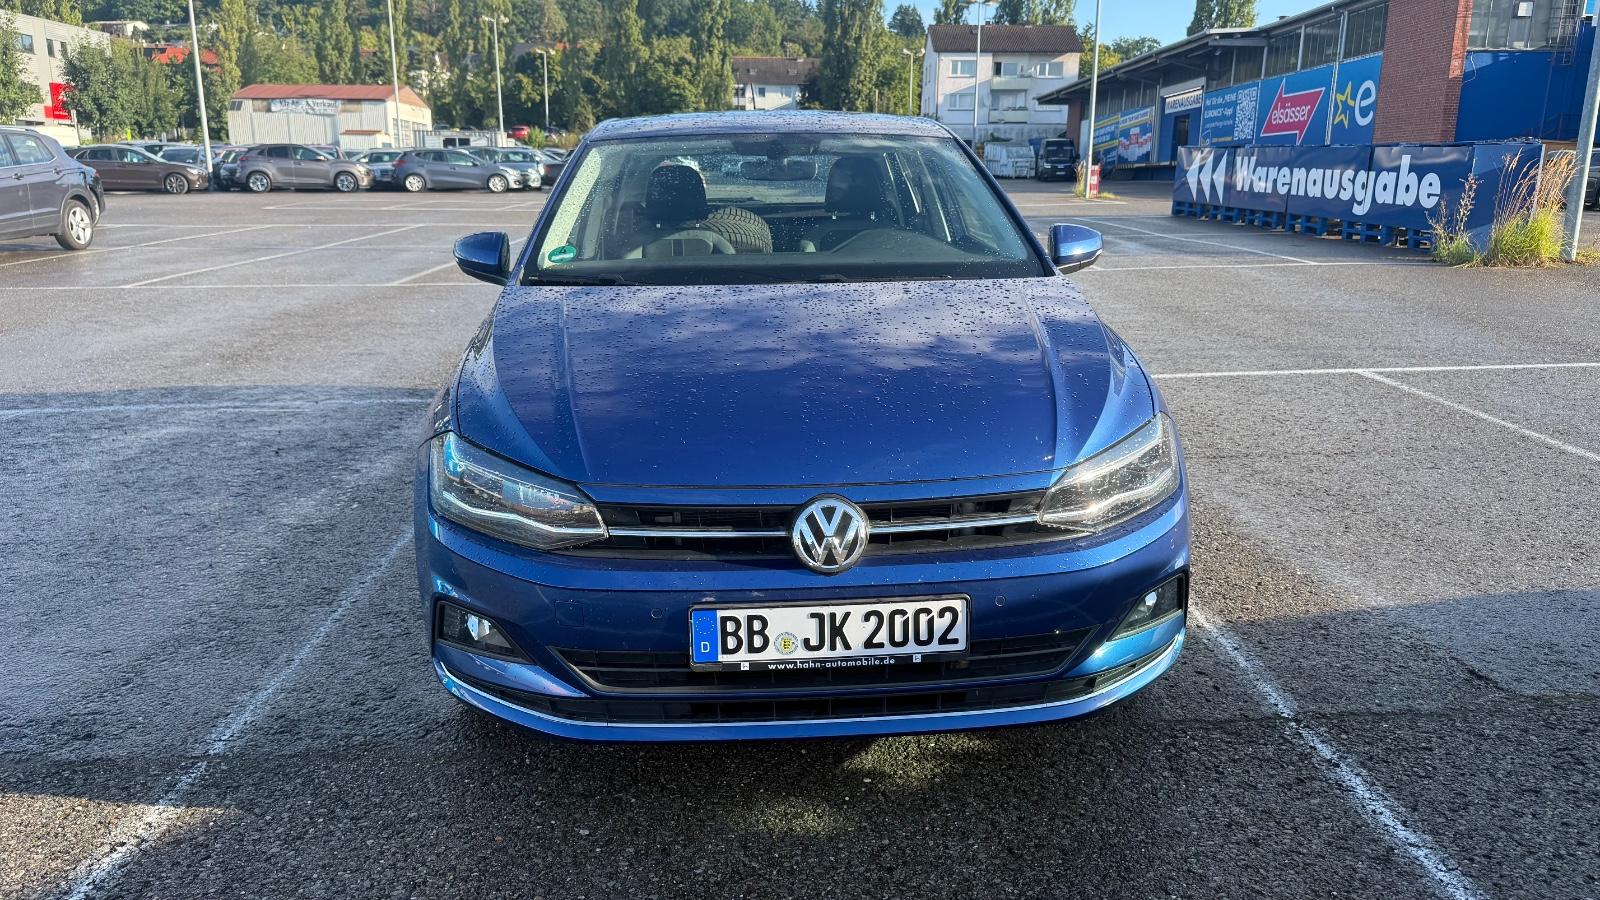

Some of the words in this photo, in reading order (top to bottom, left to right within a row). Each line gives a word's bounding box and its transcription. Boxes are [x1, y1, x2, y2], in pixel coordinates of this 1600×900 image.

[1271, 102, 1311, 125] elsässer
[1235, 154, 1441, 216] Warenausgabe
[719, 614, 771, 656] BB
[802, 610, 853, 653] JK
[863, 605, 960, 650] 2002
[701, 641, 710, 653] D
[767, 656, 896, 670] www.hahn-automobile.de
